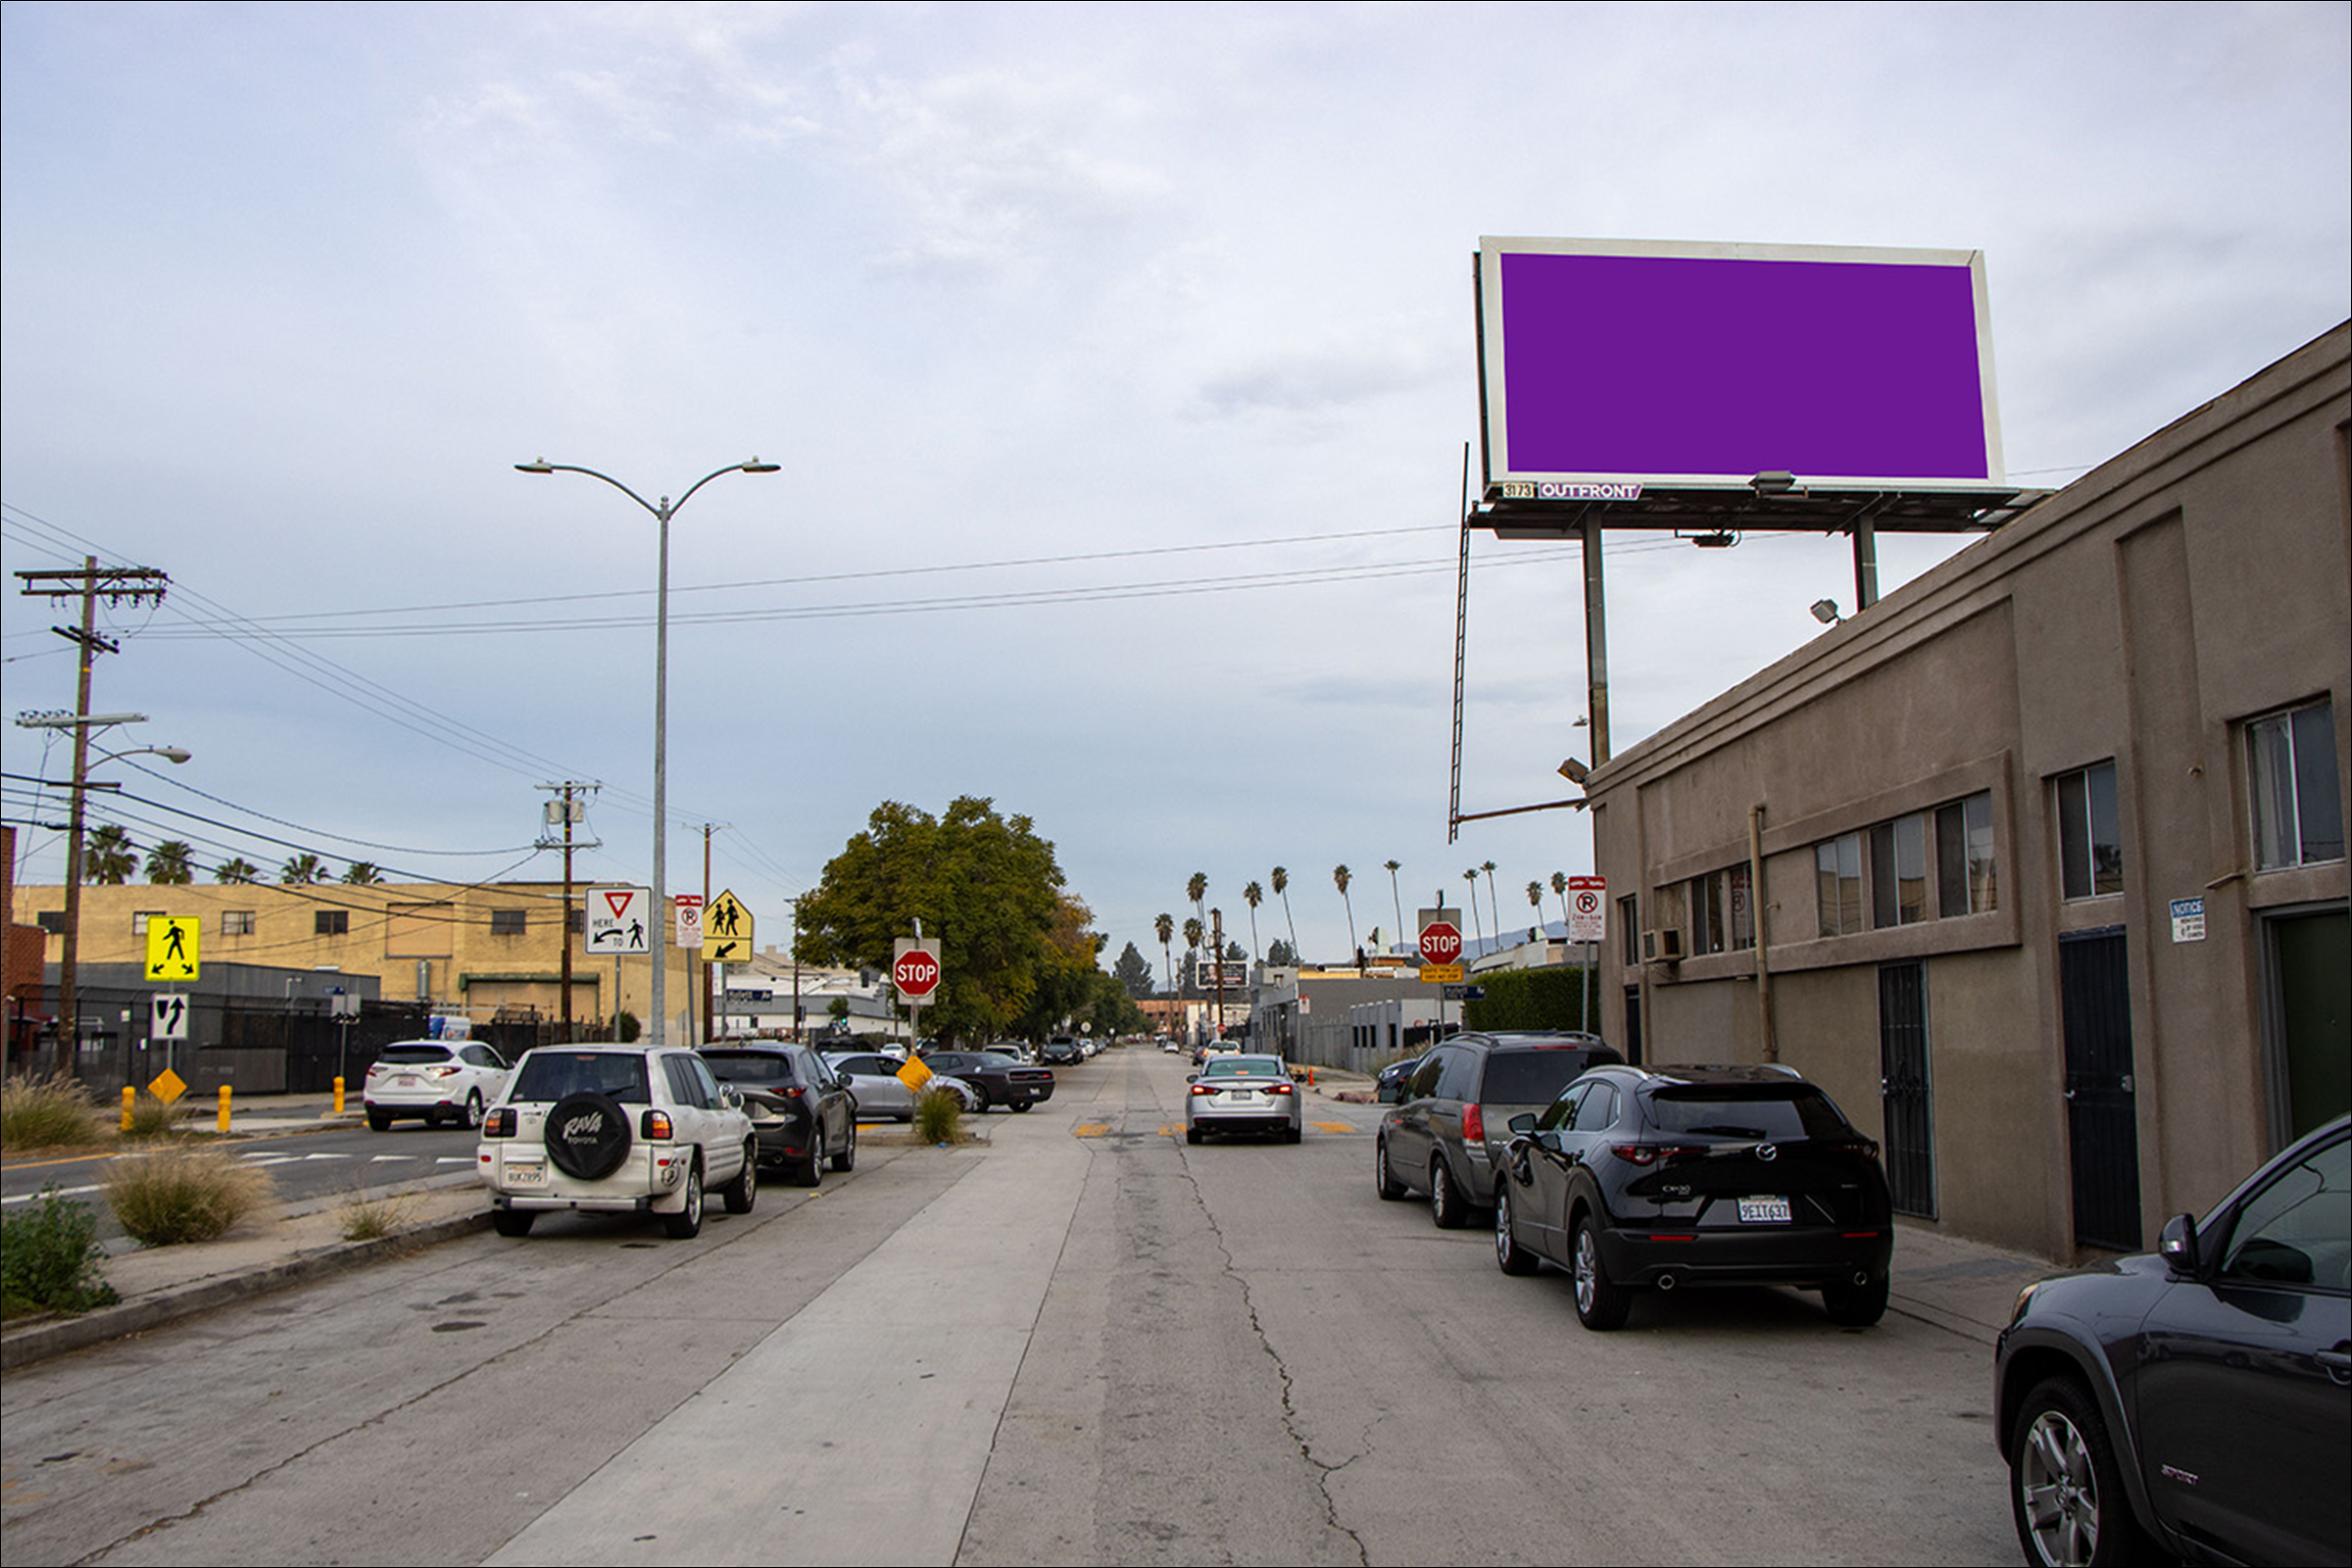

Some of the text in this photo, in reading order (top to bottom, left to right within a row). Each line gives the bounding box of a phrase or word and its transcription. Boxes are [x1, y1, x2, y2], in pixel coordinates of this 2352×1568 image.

[1504, 484, 1532, 496] 3173
[1542, 483, 1637, 498] OUTFRONT
[2173, 901, 2204, 914] NOTICE
[592, 918, 614, 928] HERE
[613, 938, 624, 948] TO
[1422, 936, 1459, 953] STOP
[897, 963, 937, 982] STOP
